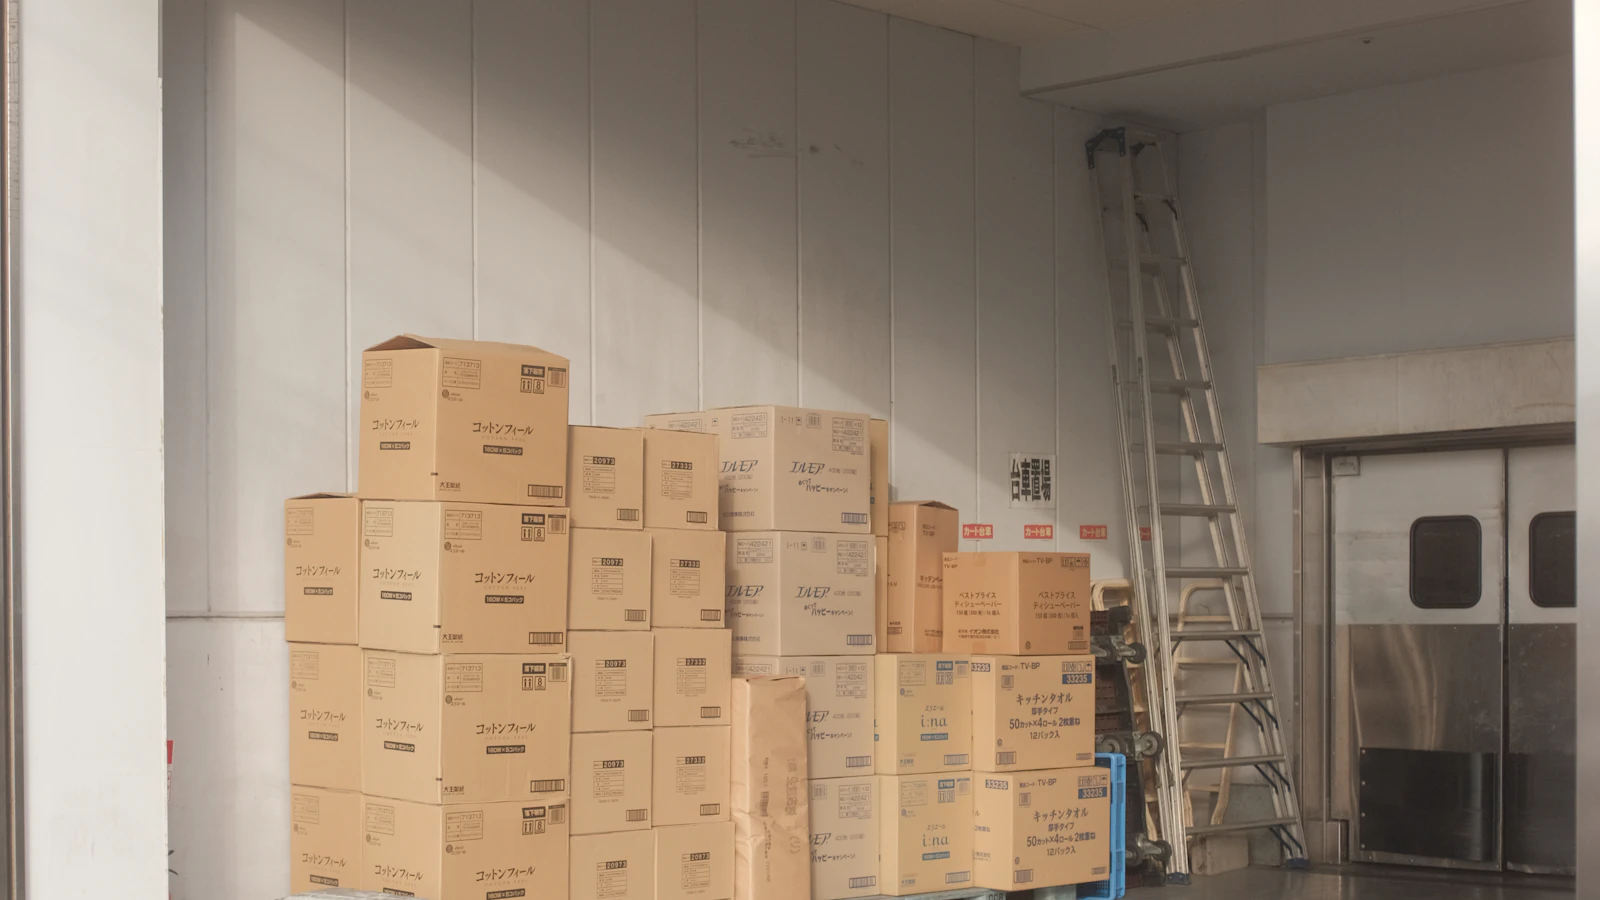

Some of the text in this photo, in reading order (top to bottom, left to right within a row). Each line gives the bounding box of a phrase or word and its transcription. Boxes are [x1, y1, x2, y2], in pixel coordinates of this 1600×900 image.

[744, 414, 766, 422] 422421
[372, 419, 419, 430] コットンフィール
[472, 421, 534, 435] コットンフィール
[843, 429, 862, 437] 422421
[594, 457, 615, 465] 20973
[671, 462, 692, 470] 27332
[720, 460, 759, 473] エルモア
[789, 461, 825, 475] エルモア
[1010, 458, 1051, 502] 台車置場
[964, 526, 992, 537] カート台車
[1025, 526, 1052, 537] カート台車
[1082, 527, 1106, 537] カート台車
[602, 558, 623, 566] 20973
[680, 560, 700, 568] 27332
[295, 565, 341, 576] コットンフィール
[373, 568, 421, 580] コットンフィール
[475, 572, 535, 584] コットンフィール
[726, 585, 764, 598] エルモア
[795, 586, 831, 599] エルモア
[1039, 591, 1076, 599] ベストプライス
[748, 665, 771, 673] 422421
[1020, 662, 1041, 670] TV-BP
[1066, 675, 1088, 683] 33235
[1016, 692, 1073, 705] キッチンタオル
[300, 709, 346, 722] コットンフィール
[1031, 707, 1059, 716] 厚手タイプ
[376, 718, 423, 732] コットンフィール
[921, 715, 948, 728] i:na
[1009, 717, 1081, 729] 50カット×4ロール 2枚重ね
[476, 723, 536, 735] コットンフィール
[1030, 730, 1060, 740] 12パック入
[603, 760, 624, 768] 20973
[685, 756, 705, 764] 27332
[986, 780, 1008, 789] 33235
[1038, 778, 1057, 787] TV-BP
[1082, 788, 1104, 798] 33235
[1033, 807, 1089, 822] キッチンタオル
[1048, 822, 1075, 832] 厚手タイプ
[922, 833, 949, 847] i:na
[1026, 831, 1096, 847] 50カット×4ロール 2枚重ね
[690, 852, 710, 861] 20973
[1047, 846, 1077, 856] 12パック入
[302, 853, 346, 868] コットンフィール
[606, 860, 627, 869] 20973
[375, 865, 423, 881] コットンフィール
[476, 866, 535, 882] コットンフィール
